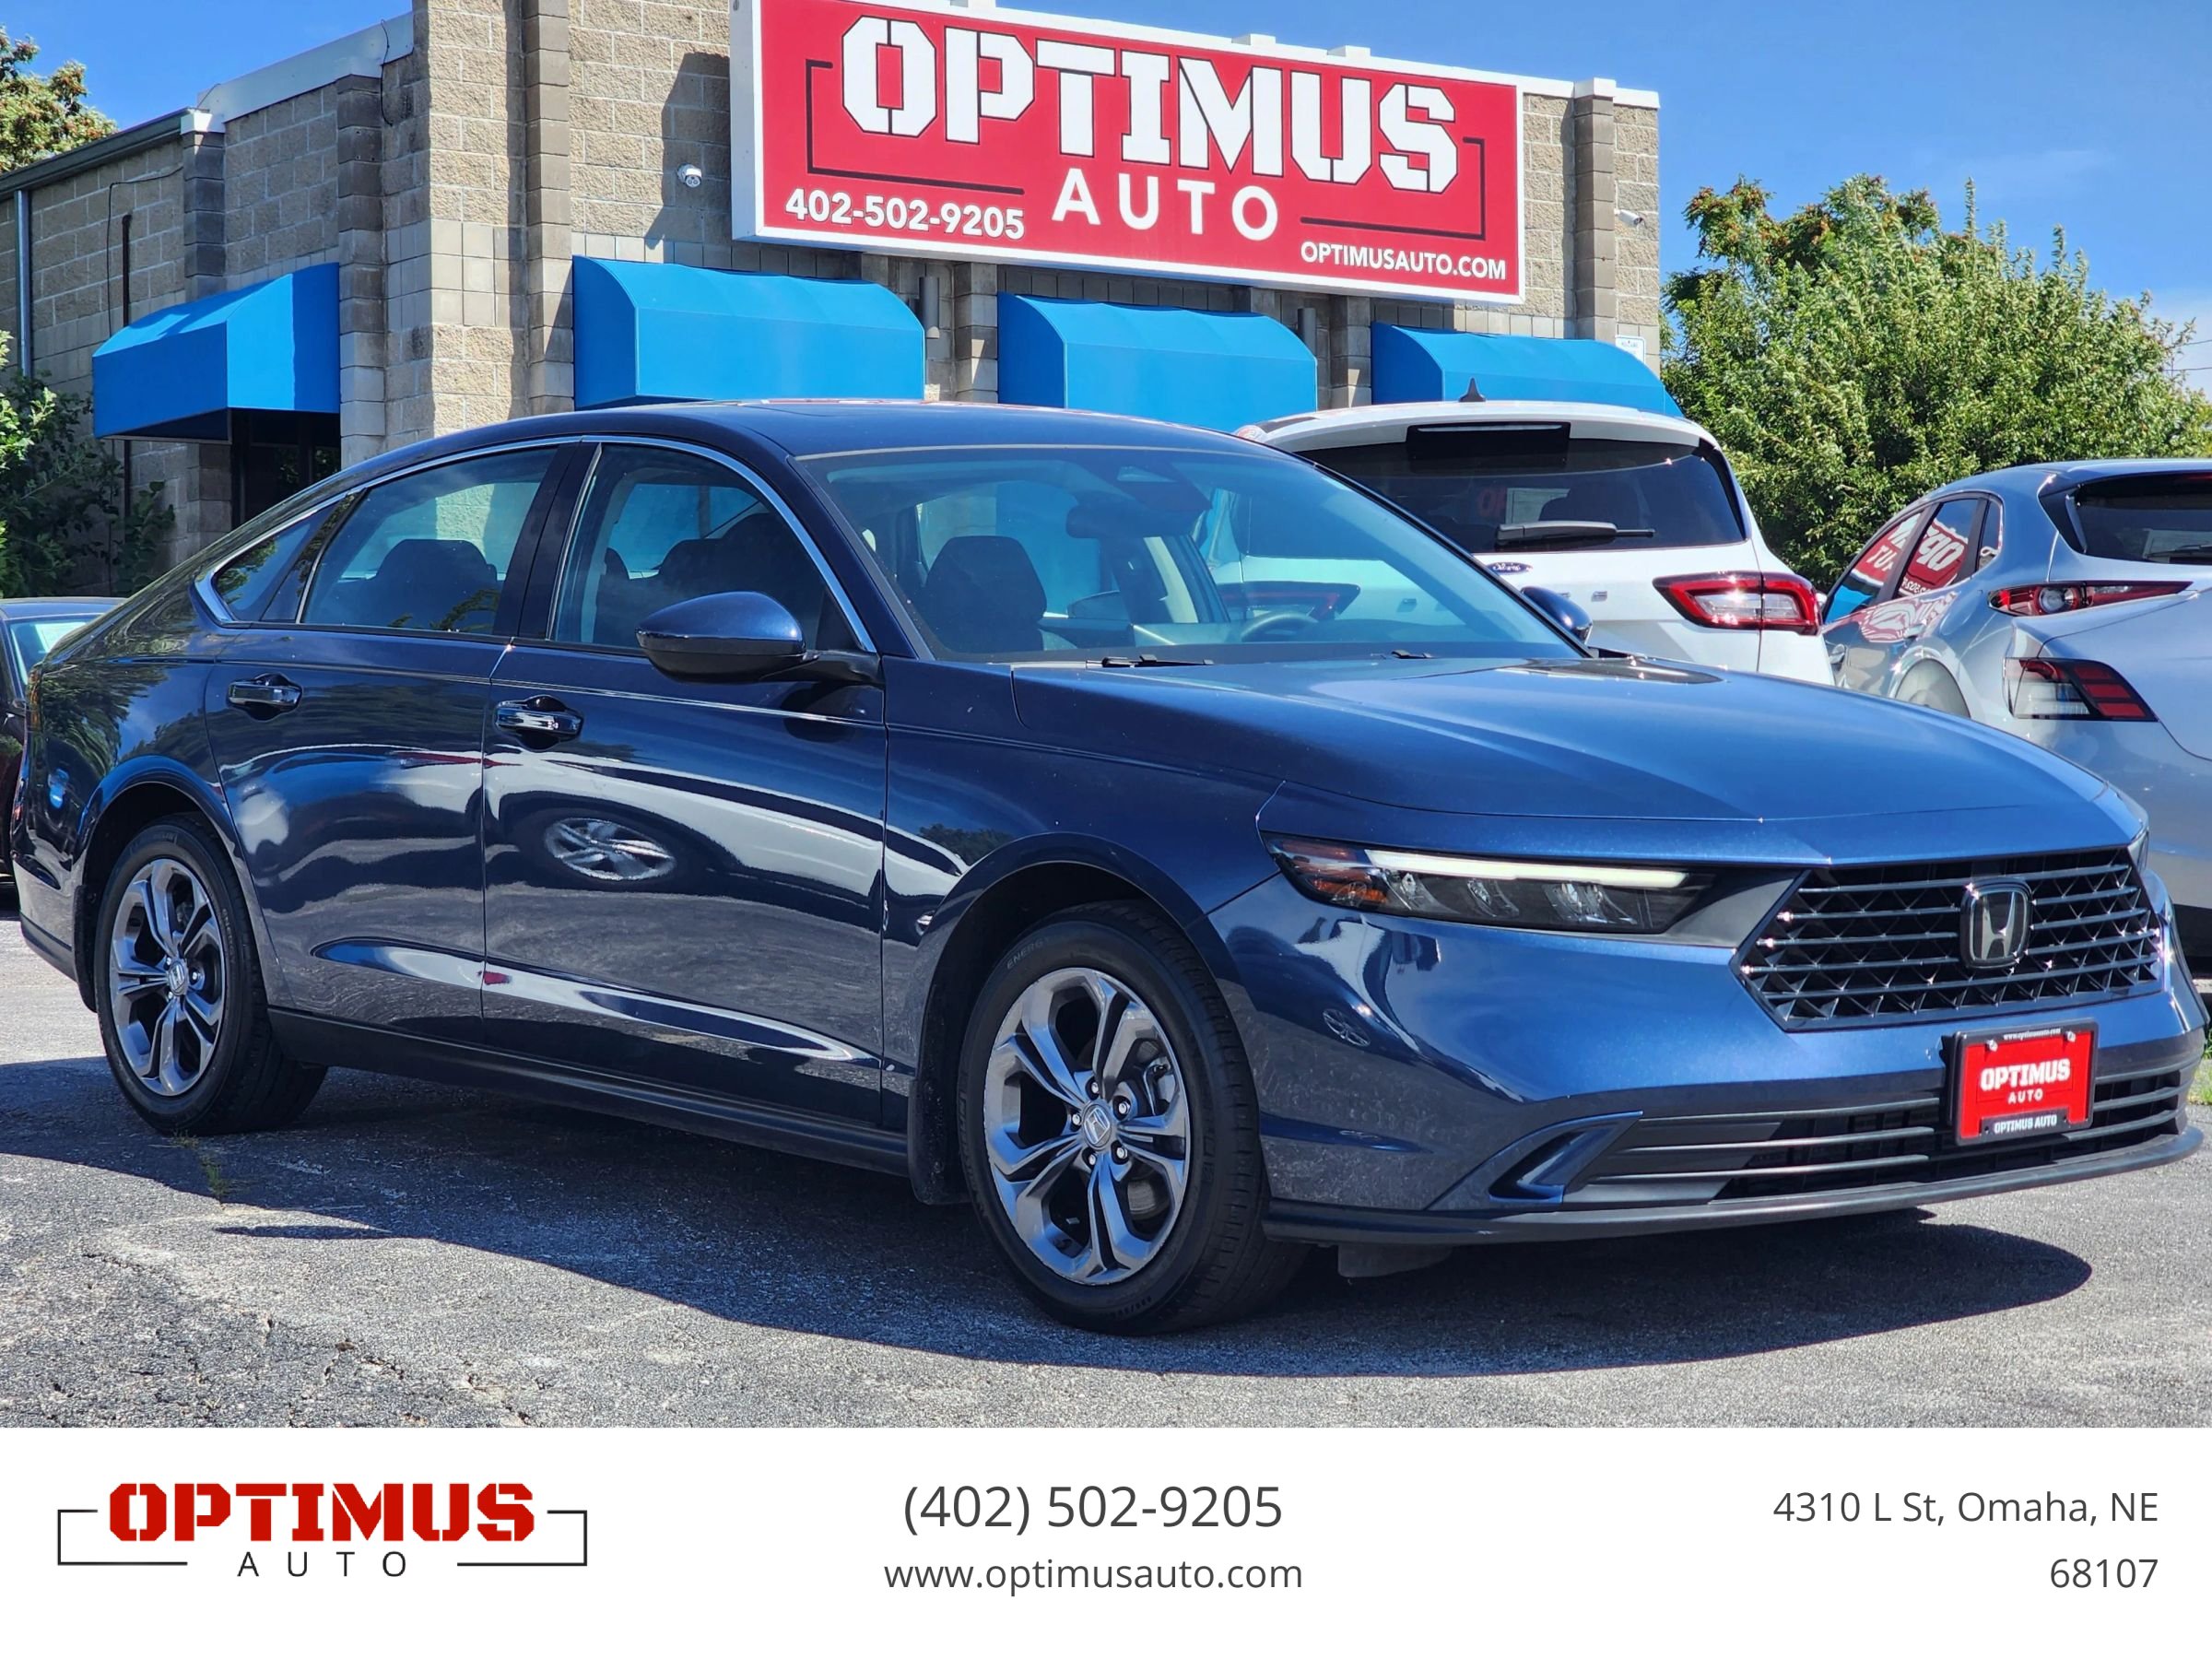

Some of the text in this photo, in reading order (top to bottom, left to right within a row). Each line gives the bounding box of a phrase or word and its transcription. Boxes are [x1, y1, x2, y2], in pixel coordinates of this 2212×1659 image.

[841, 15, 1458, 194] OPTIMUS
[785, 187, 1025, 241] 402-502-9205
[1052, 168, 1279, 241] AUTO
[1300, 241, 1506, 281] OPTIMUSAUTO.COM
[1980, 1057, 2071, 1091] OPTIMUS
[2007, 1088, 2043, 1104] AUTO
[1994, 1114, 2057, 1134] OPTIMUS AUTO
